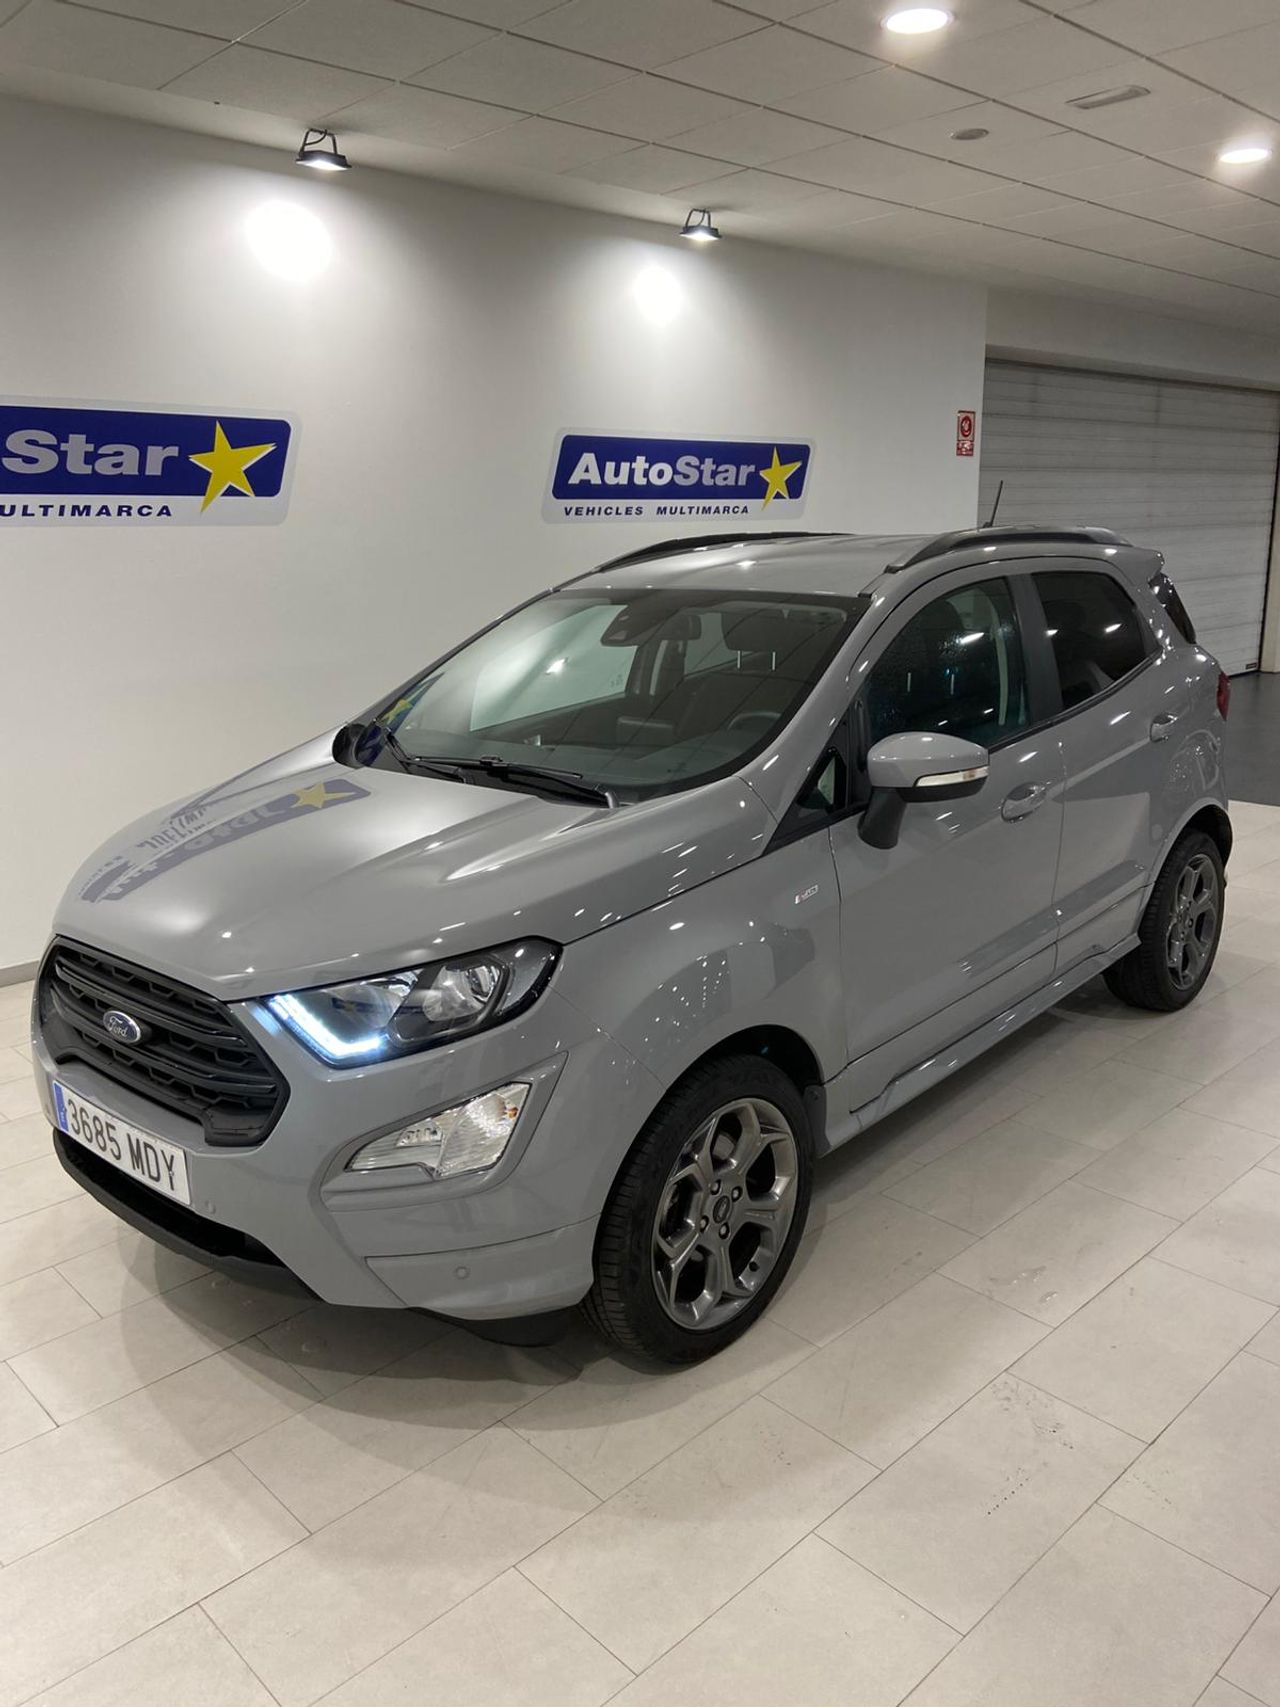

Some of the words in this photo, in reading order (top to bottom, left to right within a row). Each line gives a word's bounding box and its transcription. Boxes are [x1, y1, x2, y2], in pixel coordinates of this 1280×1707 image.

[568, 452, 755, 486] AutoStar
[564, 506, 644, 516] VEHICLES
[656, 505, 749, 515] MULTIMARCA
[108, 1015, 128, 1037] Ford
[67, 1098, 122, 1161] 3685
[127, 1132, 175, 1191] MDY
